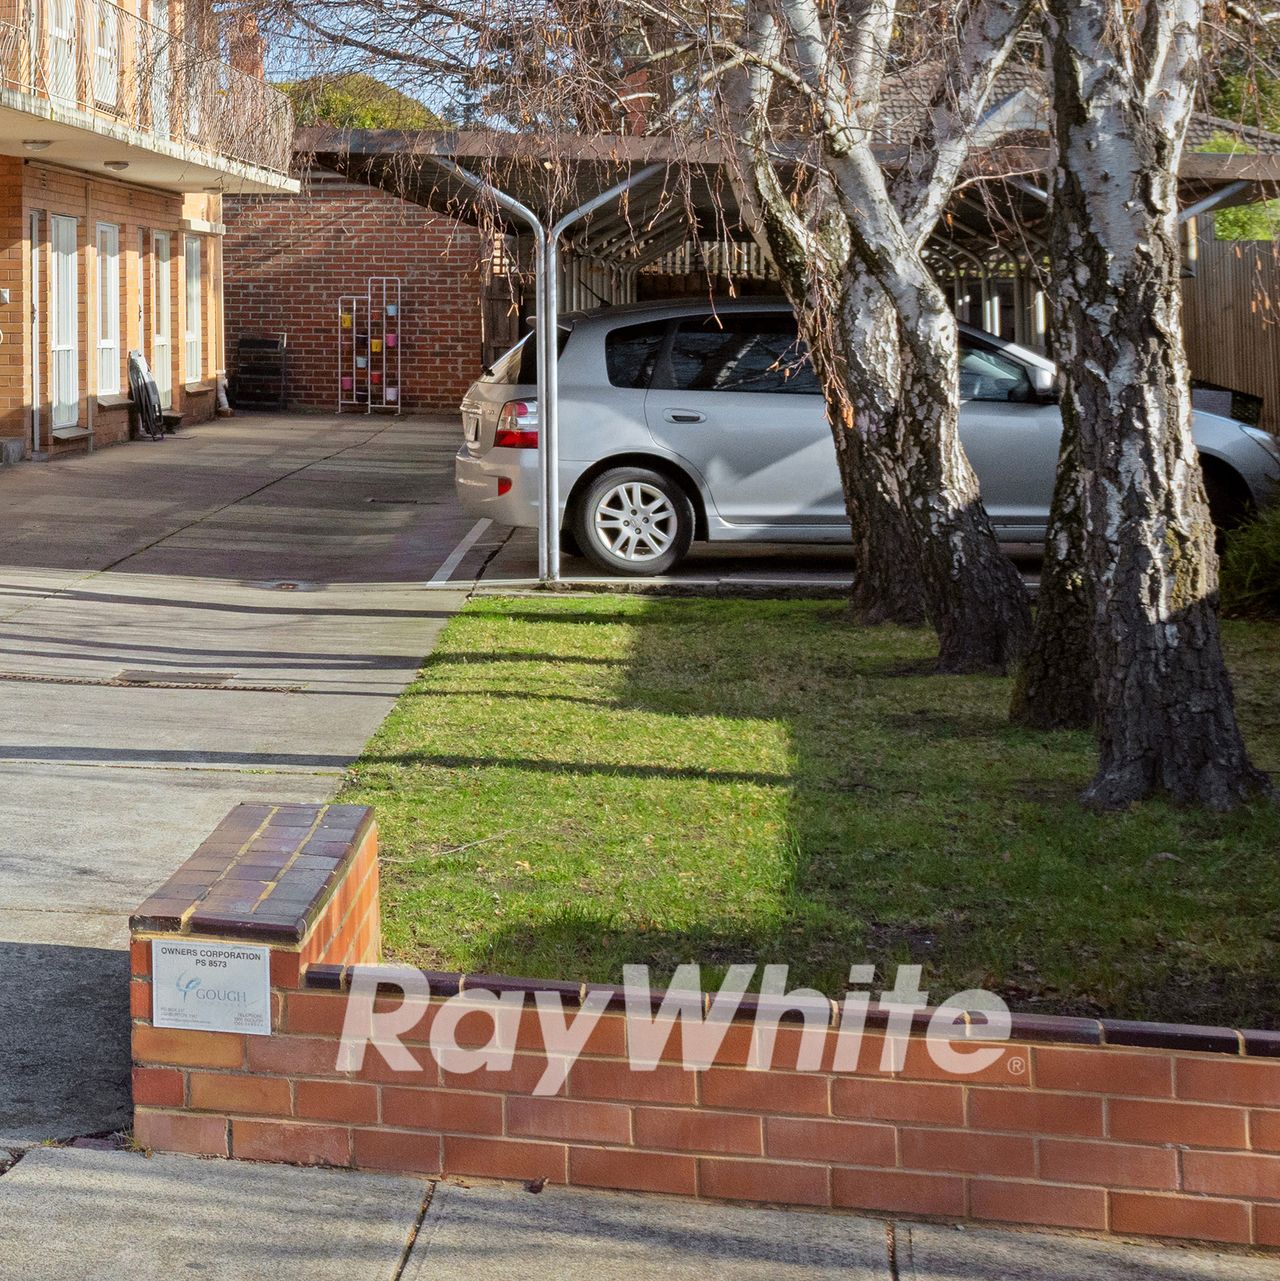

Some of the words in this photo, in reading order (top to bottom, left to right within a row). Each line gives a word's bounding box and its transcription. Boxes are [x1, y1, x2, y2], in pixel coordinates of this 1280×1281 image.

[161, 947, 198, 957] OWNERS
[199, 949, 261, 961] CORPORATION
[195, 959, 207, 967] PS
[208, 959, 228, 968] 8573
[195, 988, 247, 1003] GOUGH
